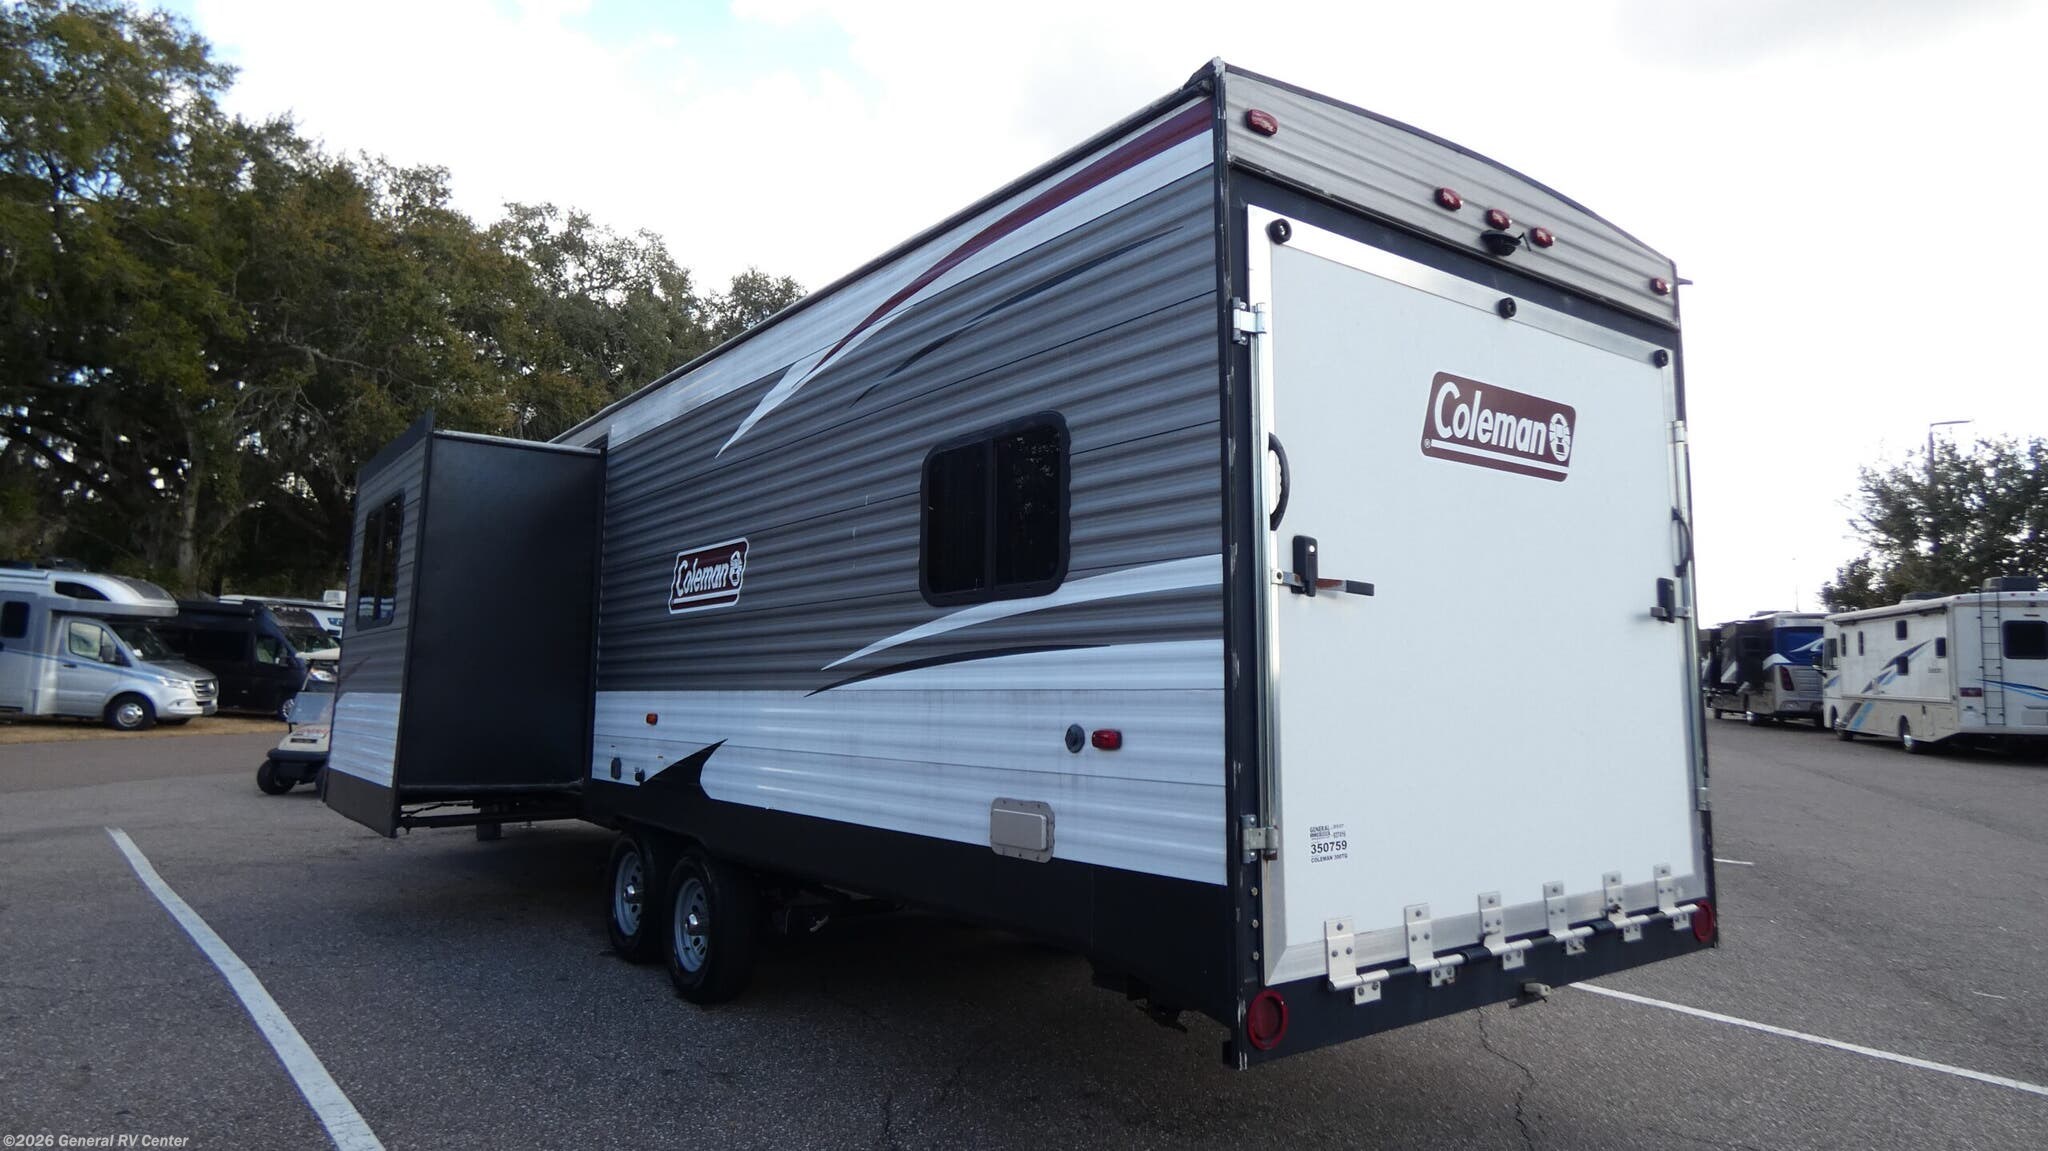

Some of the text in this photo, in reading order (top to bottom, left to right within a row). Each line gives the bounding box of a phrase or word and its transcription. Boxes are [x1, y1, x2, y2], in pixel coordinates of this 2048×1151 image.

[1434, 381, 1548, 456] Coleman
[675, 557, 729, 597] Coleman
[1310, 840, 1348, 855] 350759
[1311, 855, 1333, 864] COLEMAN
